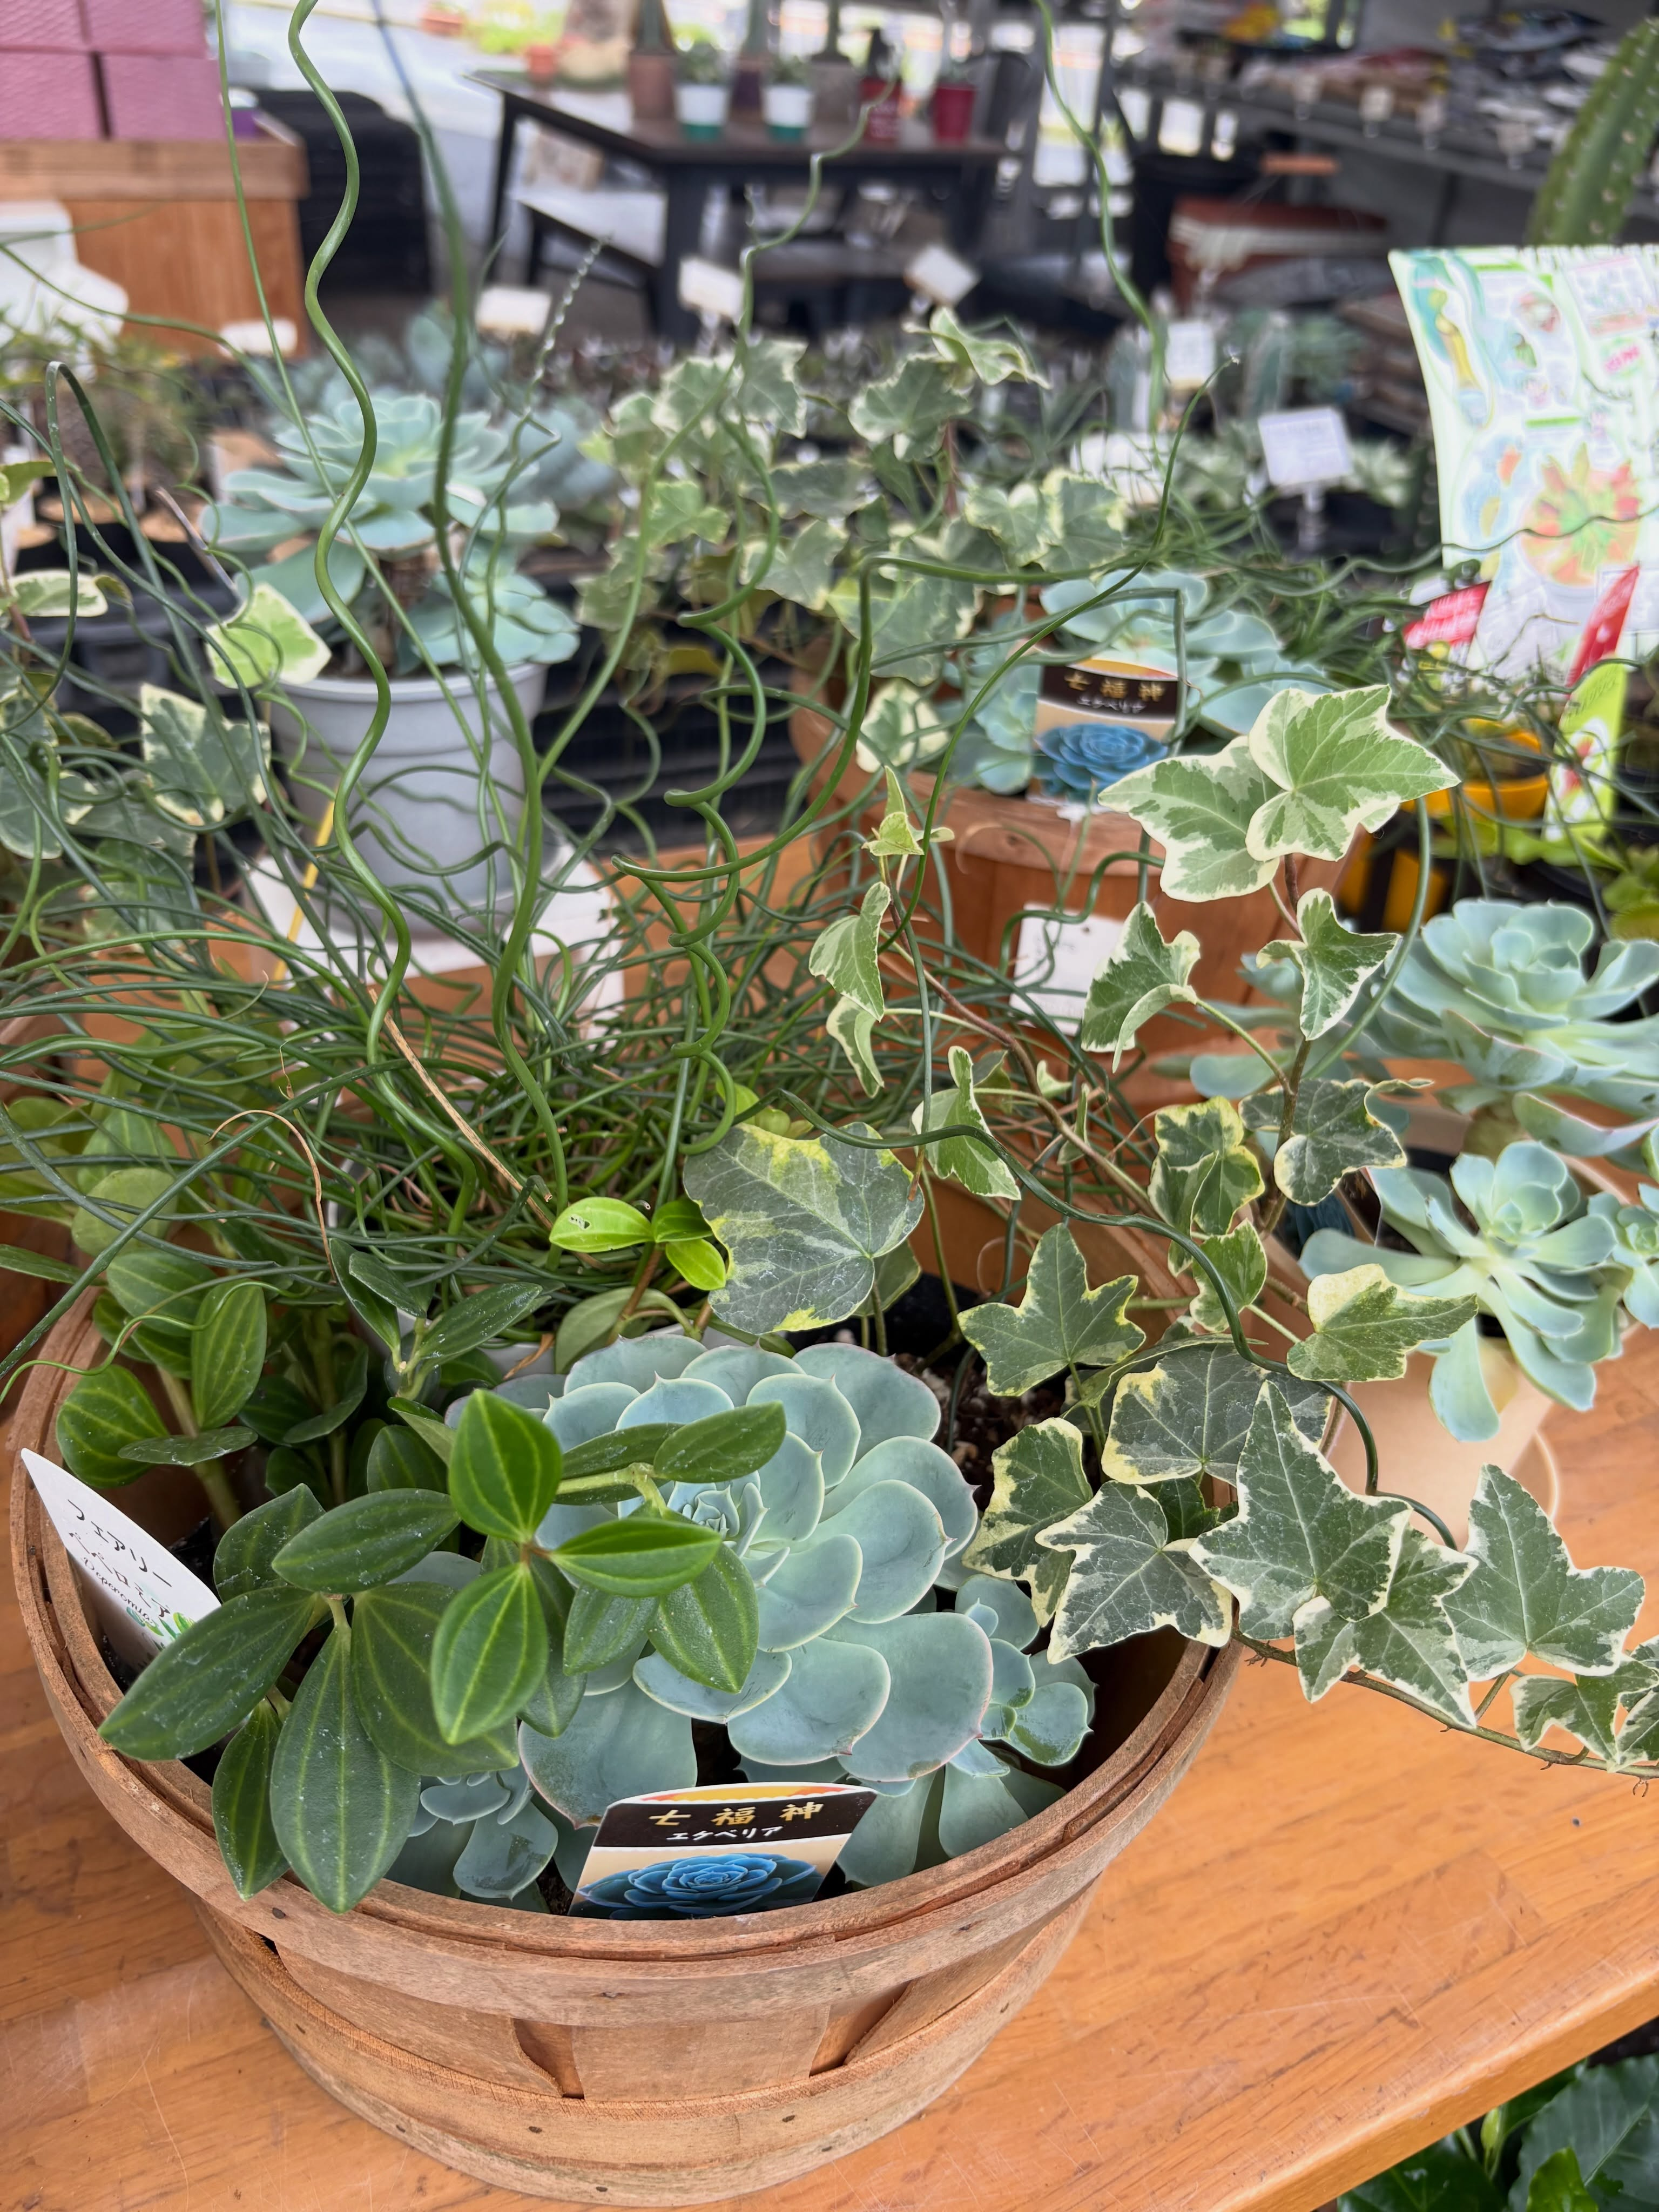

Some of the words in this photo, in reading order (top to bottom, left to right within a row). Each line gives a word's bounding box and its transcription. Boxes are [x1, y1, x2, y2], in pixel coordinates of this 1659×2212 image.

[69, 1532, 171, 1617] ペペロミア
[83, 1557, 153, 1621] Peperomia
[649, 1802, 825, 1826] 七福神
[665, 1826, 784, 1840] エケベリア
